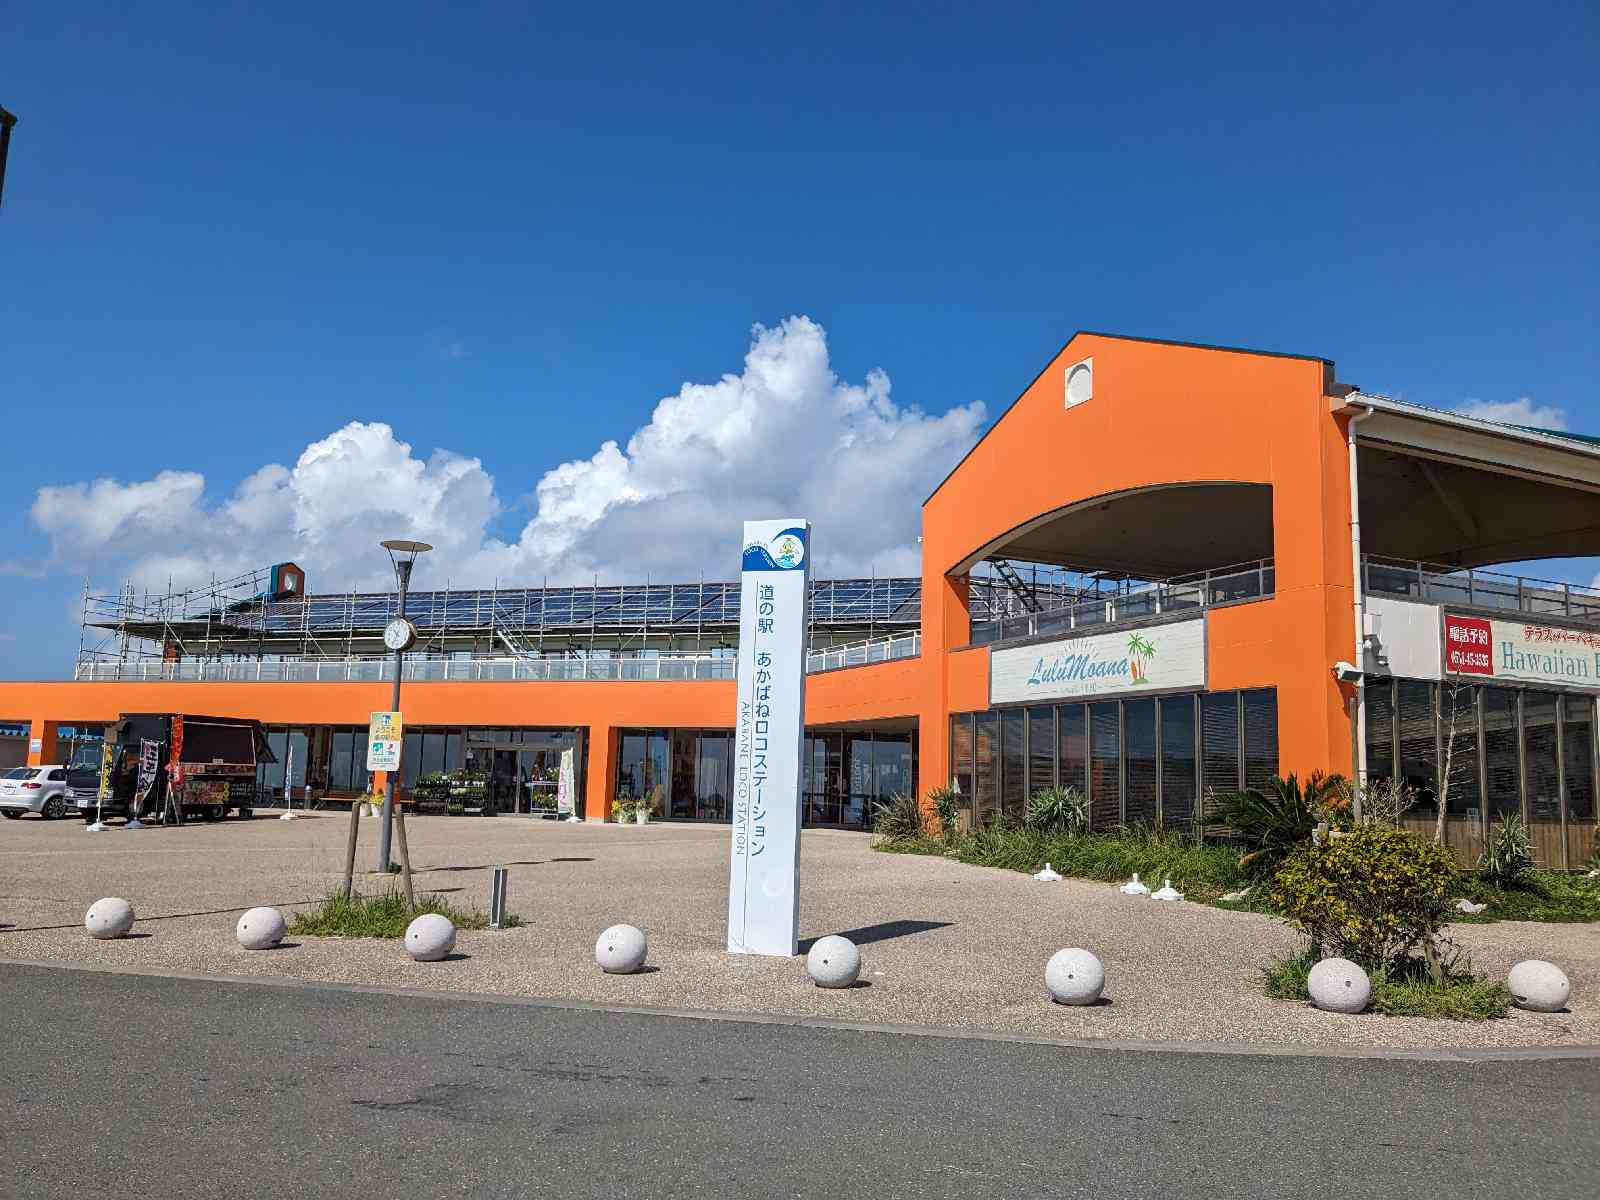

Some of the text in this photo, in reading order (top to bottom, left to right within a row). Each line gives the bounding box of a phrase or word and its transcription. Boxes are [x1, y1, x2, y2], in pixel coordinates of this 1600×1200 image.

[1449, 626, 1489, 646] 電話予約
[1501, 641, 1588, 679] Hawaiian
[751, 584, 775, 857] 道の駅 あかばねロコステーション
[736, 701, 751, 856] AKABANE LOCO STATION
